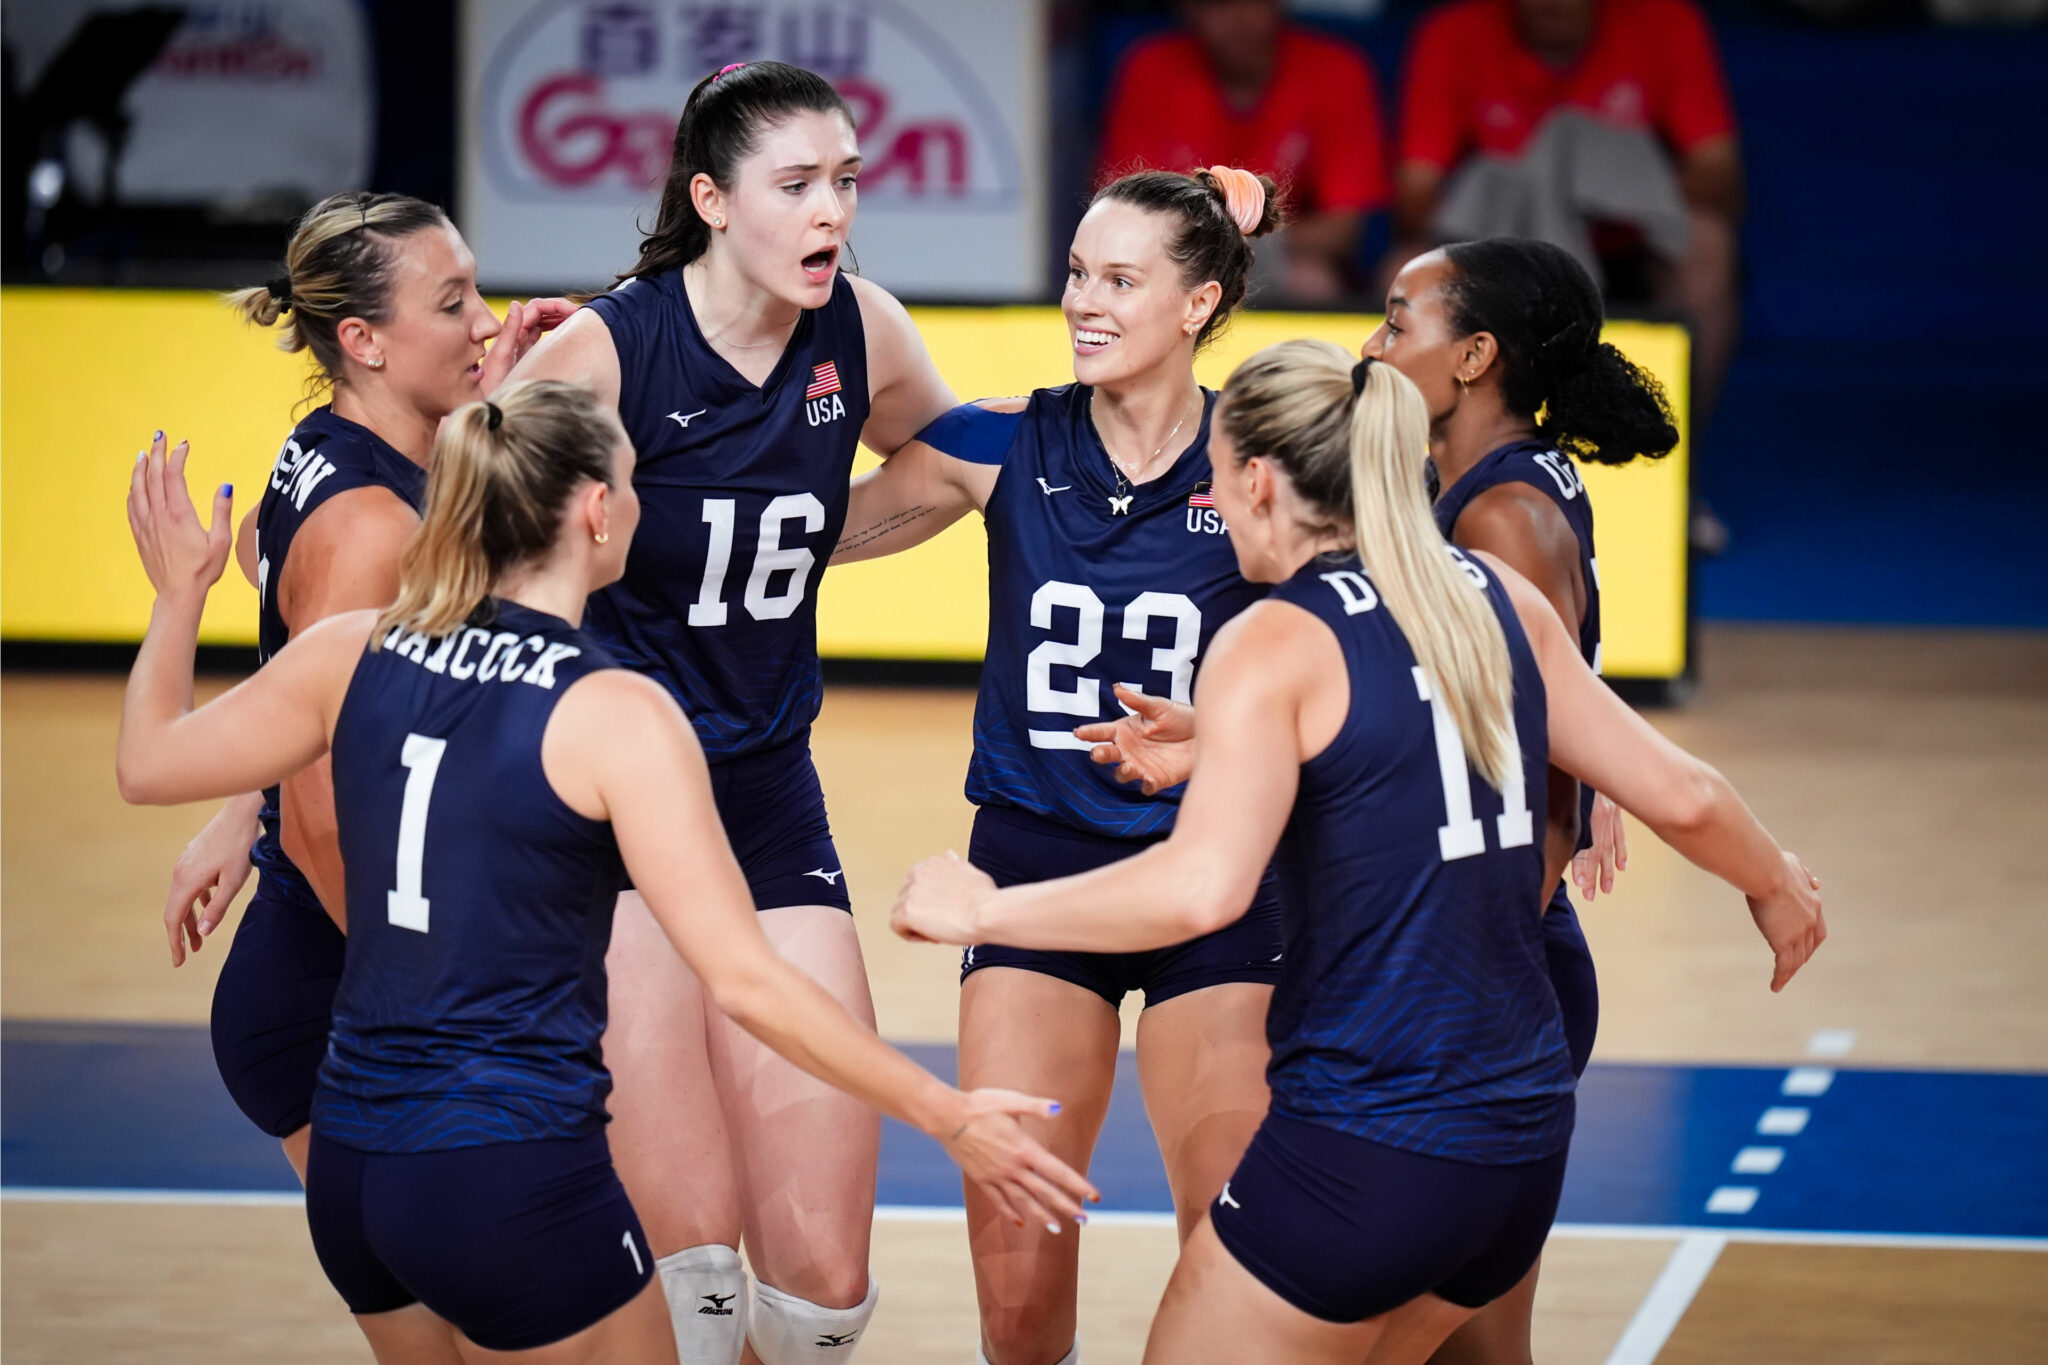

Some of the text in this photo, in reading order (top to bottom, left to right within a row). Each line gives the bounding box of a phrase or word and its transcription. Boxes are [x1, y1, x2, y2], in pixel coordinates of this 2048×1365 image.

[806, 394, 846, 427] USA
[687, 492, 825, 627] 16
[1027, 580, 1202, 717] 23
[1410, 665, 1534, 862] 11
[387, 732, 447, 934] 1
[622, 1230, 644, 1275] 1
